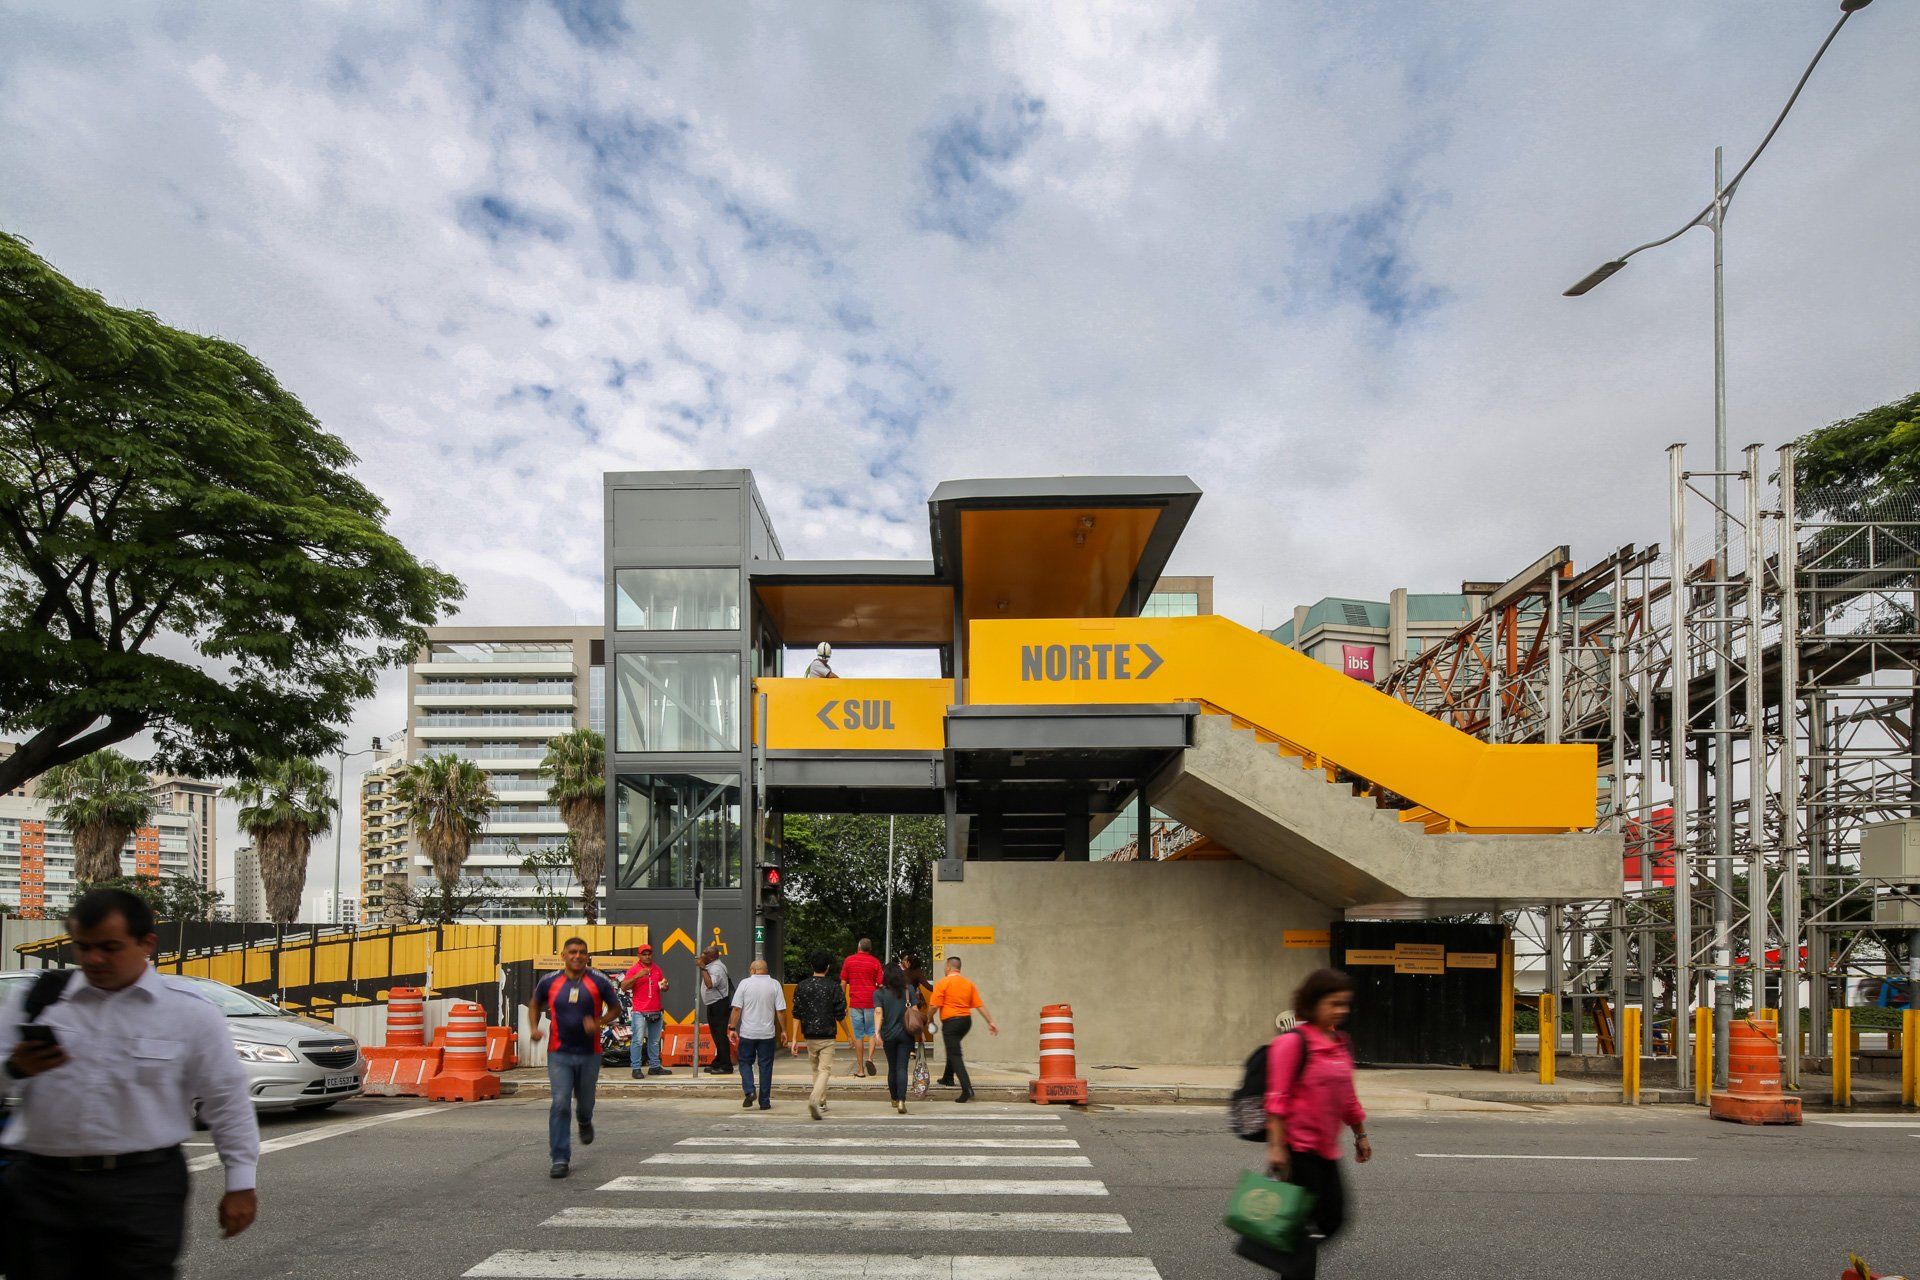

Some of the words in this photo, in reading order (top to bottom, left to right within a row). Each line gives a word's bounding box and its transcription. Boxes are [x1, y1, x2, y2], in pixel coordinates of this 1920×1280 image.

[1021, 644, 1131, 681] NORTE
[1348, 656, 1370, 670] ibis
[843, 699, 896, 730] SUL
